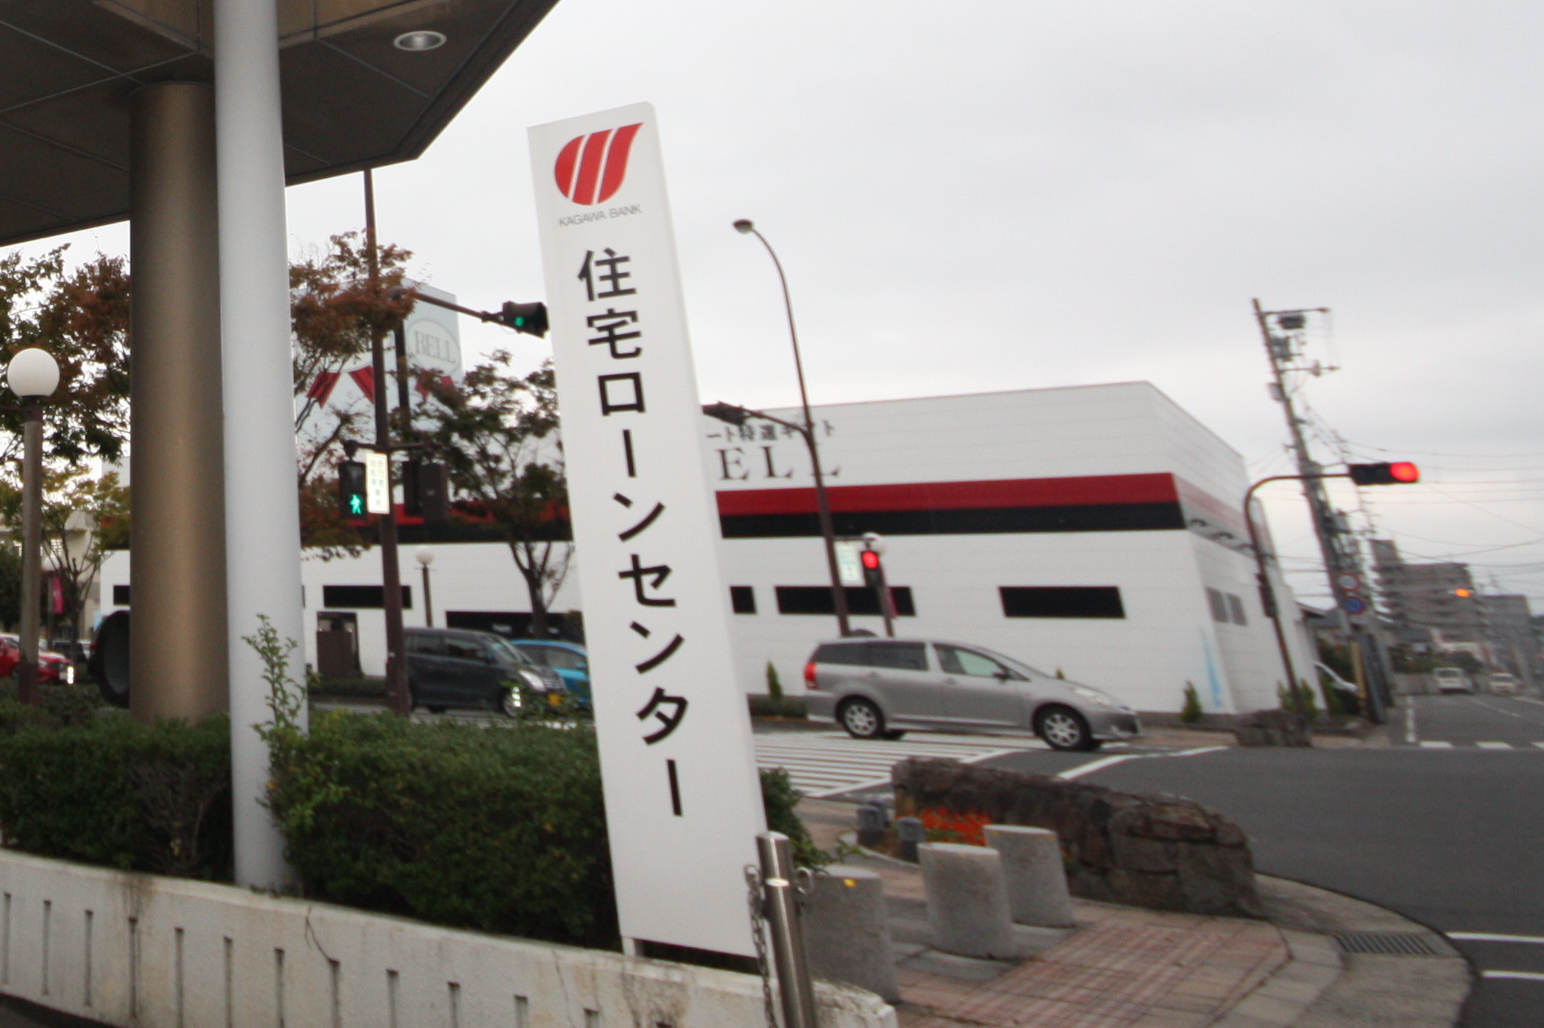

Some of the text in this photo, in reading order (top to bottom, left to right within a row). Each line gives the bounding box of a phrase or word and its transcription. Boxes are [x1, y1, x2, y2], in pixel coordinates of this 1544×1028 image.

[558, 203, 643, 228] KAGAWA BANK
[576, 247, 690, 818] 住宅ローンセンター
